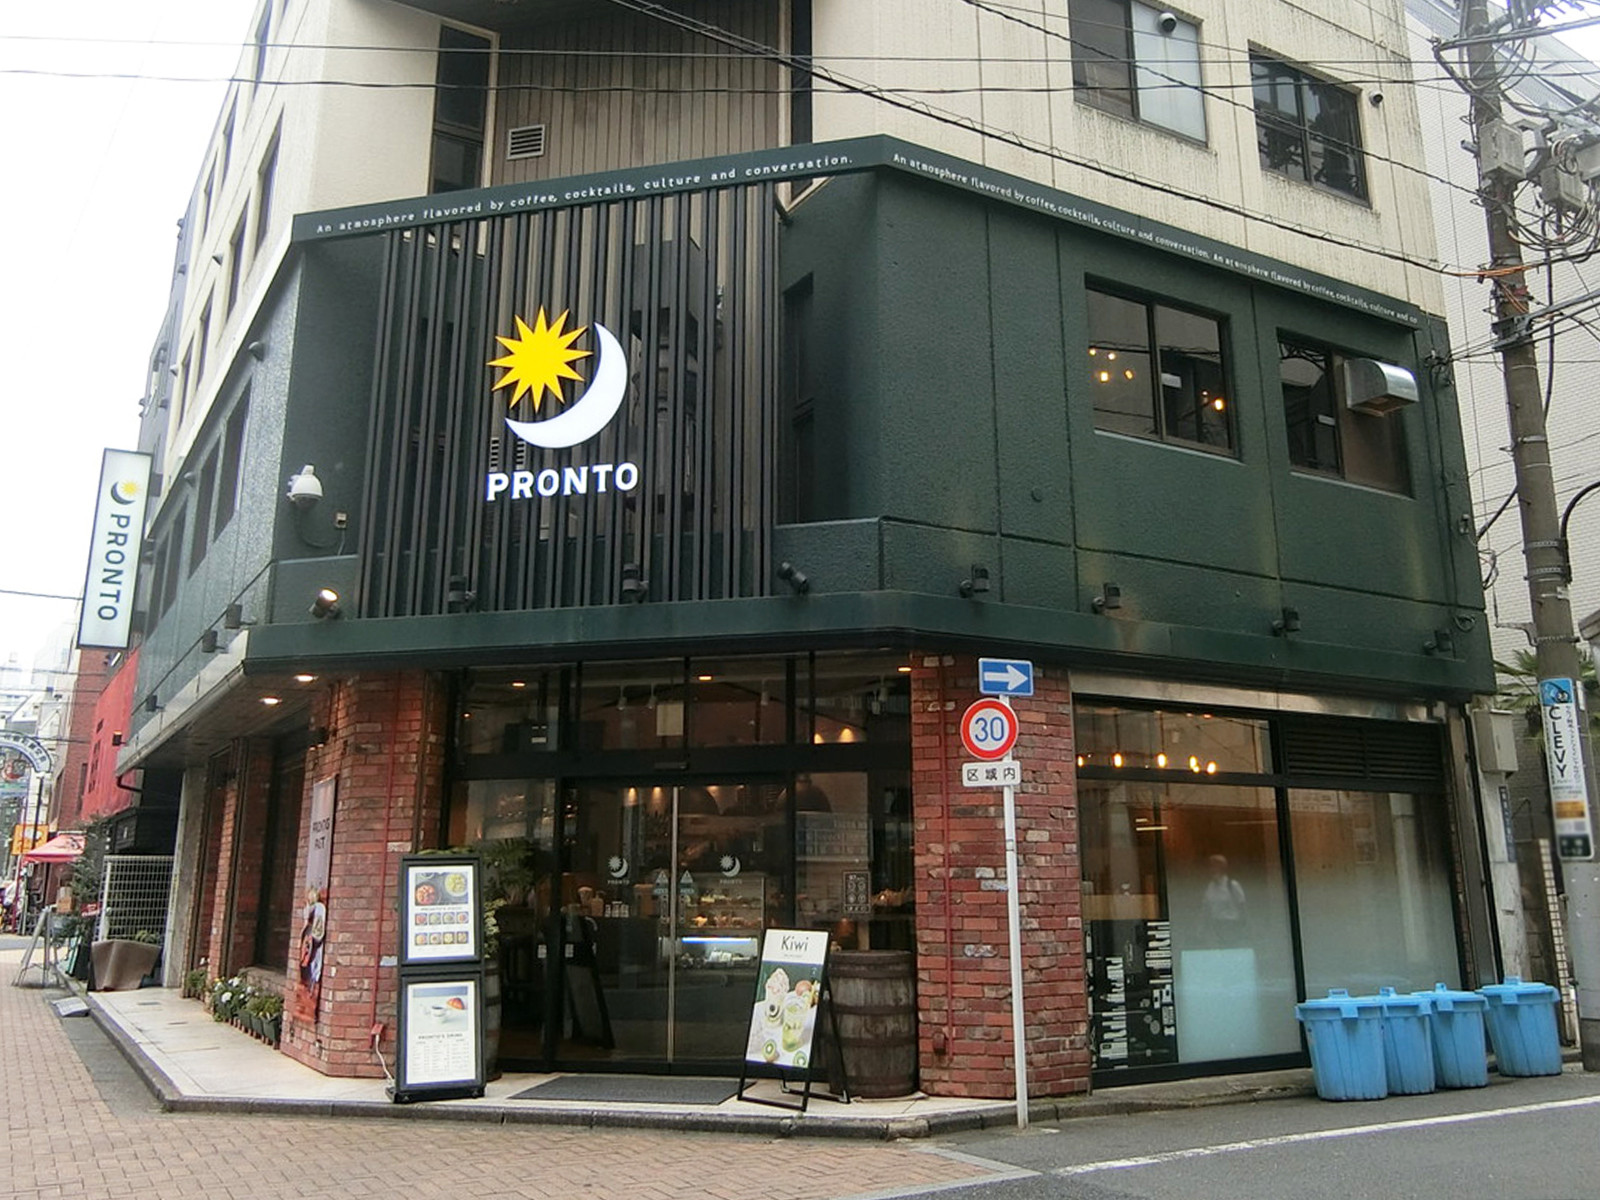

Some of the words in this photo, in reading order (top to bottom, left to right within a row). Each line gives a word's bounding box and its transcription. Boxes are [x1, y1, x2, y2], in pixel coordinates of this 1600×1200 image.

[316, 224, 332, 234] An
[423, 202, 482, 219] flavored
[490, 200, 504, 211] by
[510, 193, 558, 208] coffee,
[564, 182, 636, 201] cocktails,
[643, 174, 701, 190] culture
[711, 168, 736, 181] and
[745, 155, 853, 177] conversation.
[893, 153, 907, 165] An
[971, 177, 1012, 197] flavored
[1013, 189, 1025, 203] by
[1025, 195, 1057, 213] coffee,
[1102, 219, 1137, 236] culture
[1138, 230, 1153, 241] and
[487, 462, 639, 501] PRONTO
[97, 513, 131, 621] PRONTO
[974, 716, 1005, 742] 30
[1549, 706, 1567, 778] CLEVY
[966, 766, 1017, 782] 区域内
[780, 935, 810, 951] Kiwi
